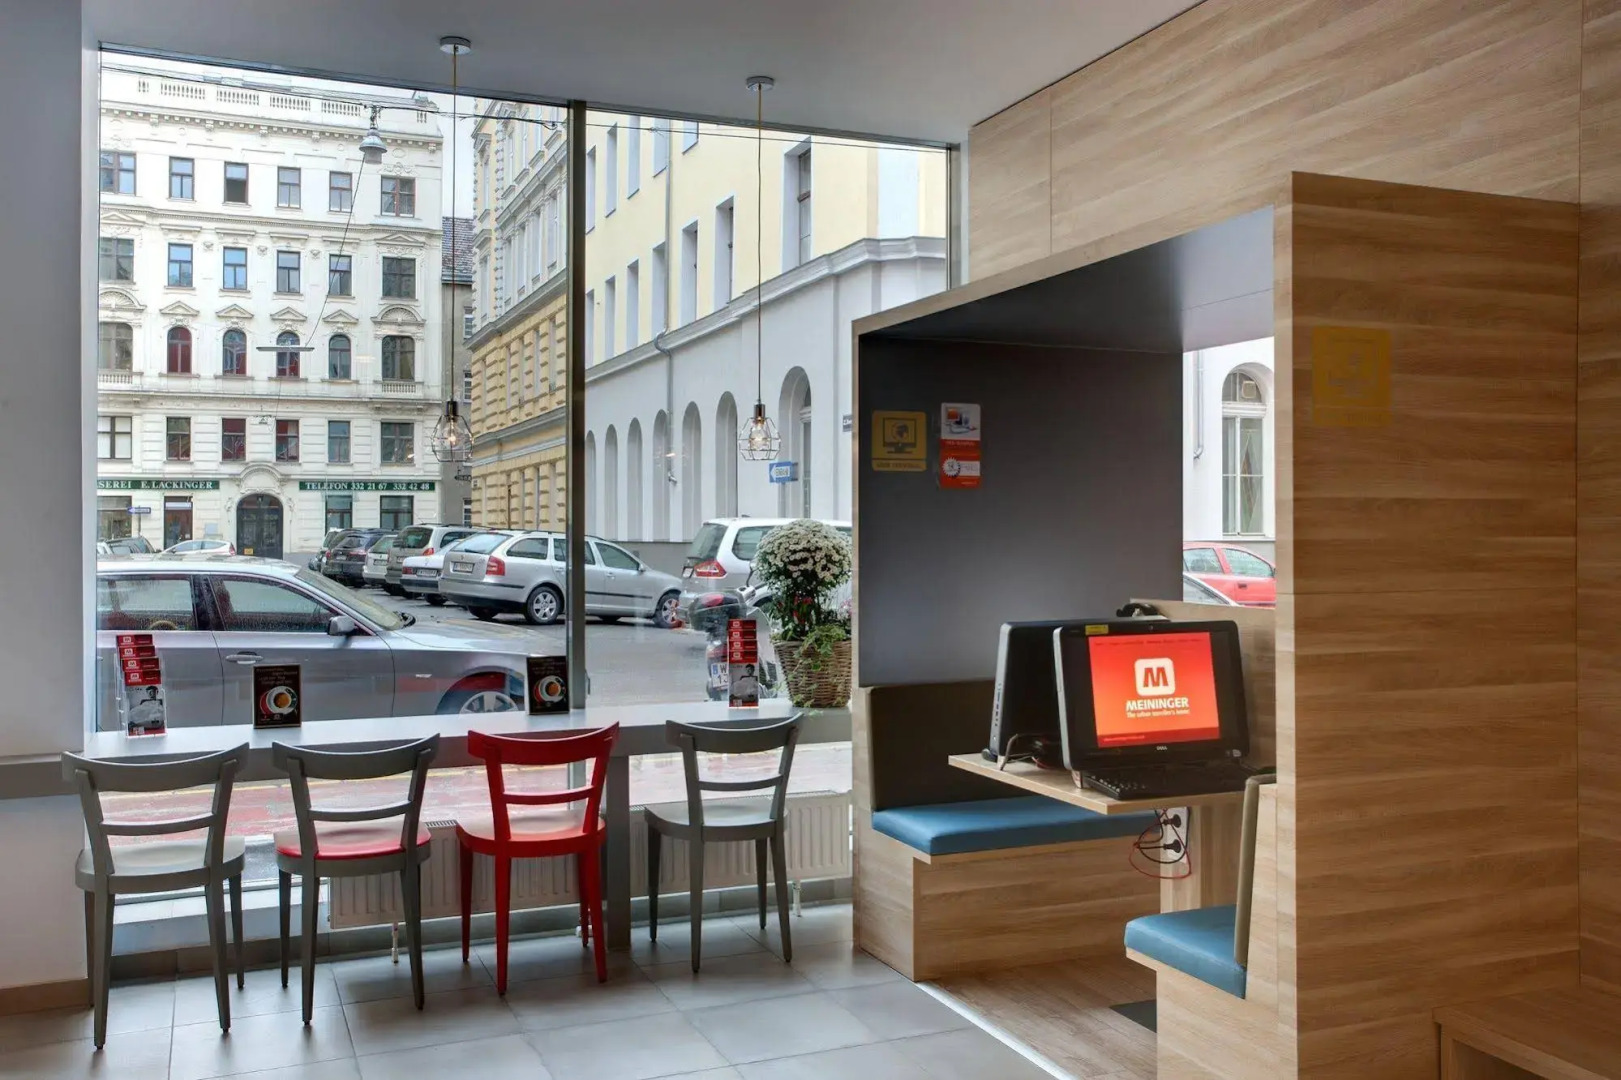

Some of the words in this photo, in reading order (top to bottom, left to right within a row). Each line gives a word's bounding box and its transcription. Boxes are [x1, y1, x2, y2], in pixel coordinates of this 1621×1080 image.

[97, 481, 132, 489] SEREI
[152, 481, 213, 489] LACKINGER
[305, 482, 348, 490] TELEFON
[1143, 666, 1169, 688] M
[1126, 697, 1189, 711] MEININGER
